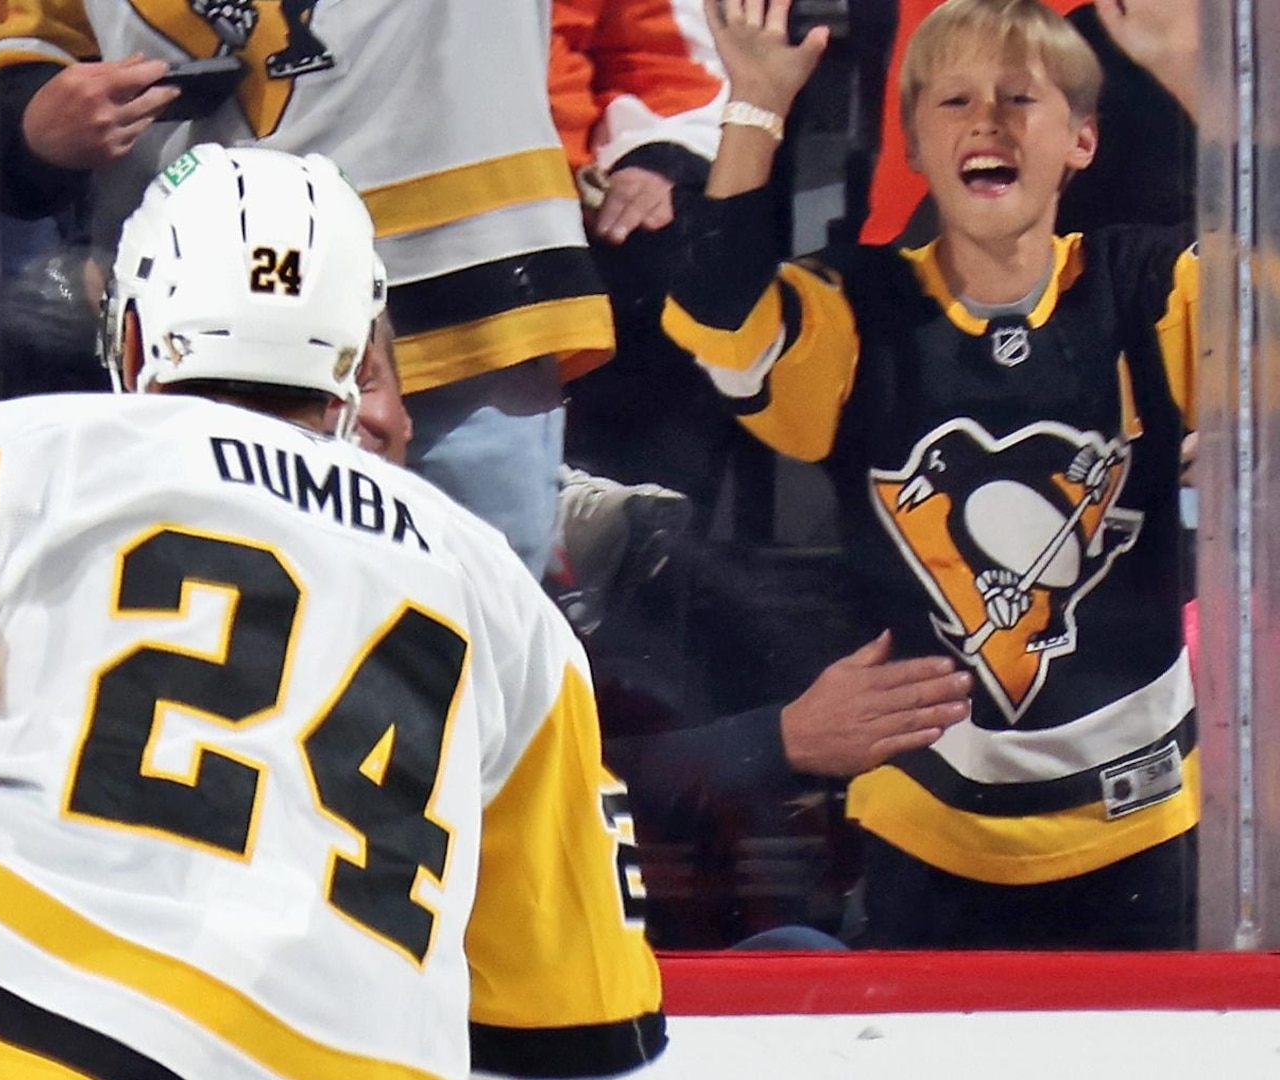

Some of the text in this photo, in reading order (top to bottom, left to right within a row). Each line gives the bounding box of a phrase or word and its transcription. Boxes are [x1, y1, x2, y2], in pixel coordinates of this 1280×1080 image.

[250, 247, 302, 297] 24
[209, 436, 431, 554] DUMBA
[59, 521, 471, 969] 24
